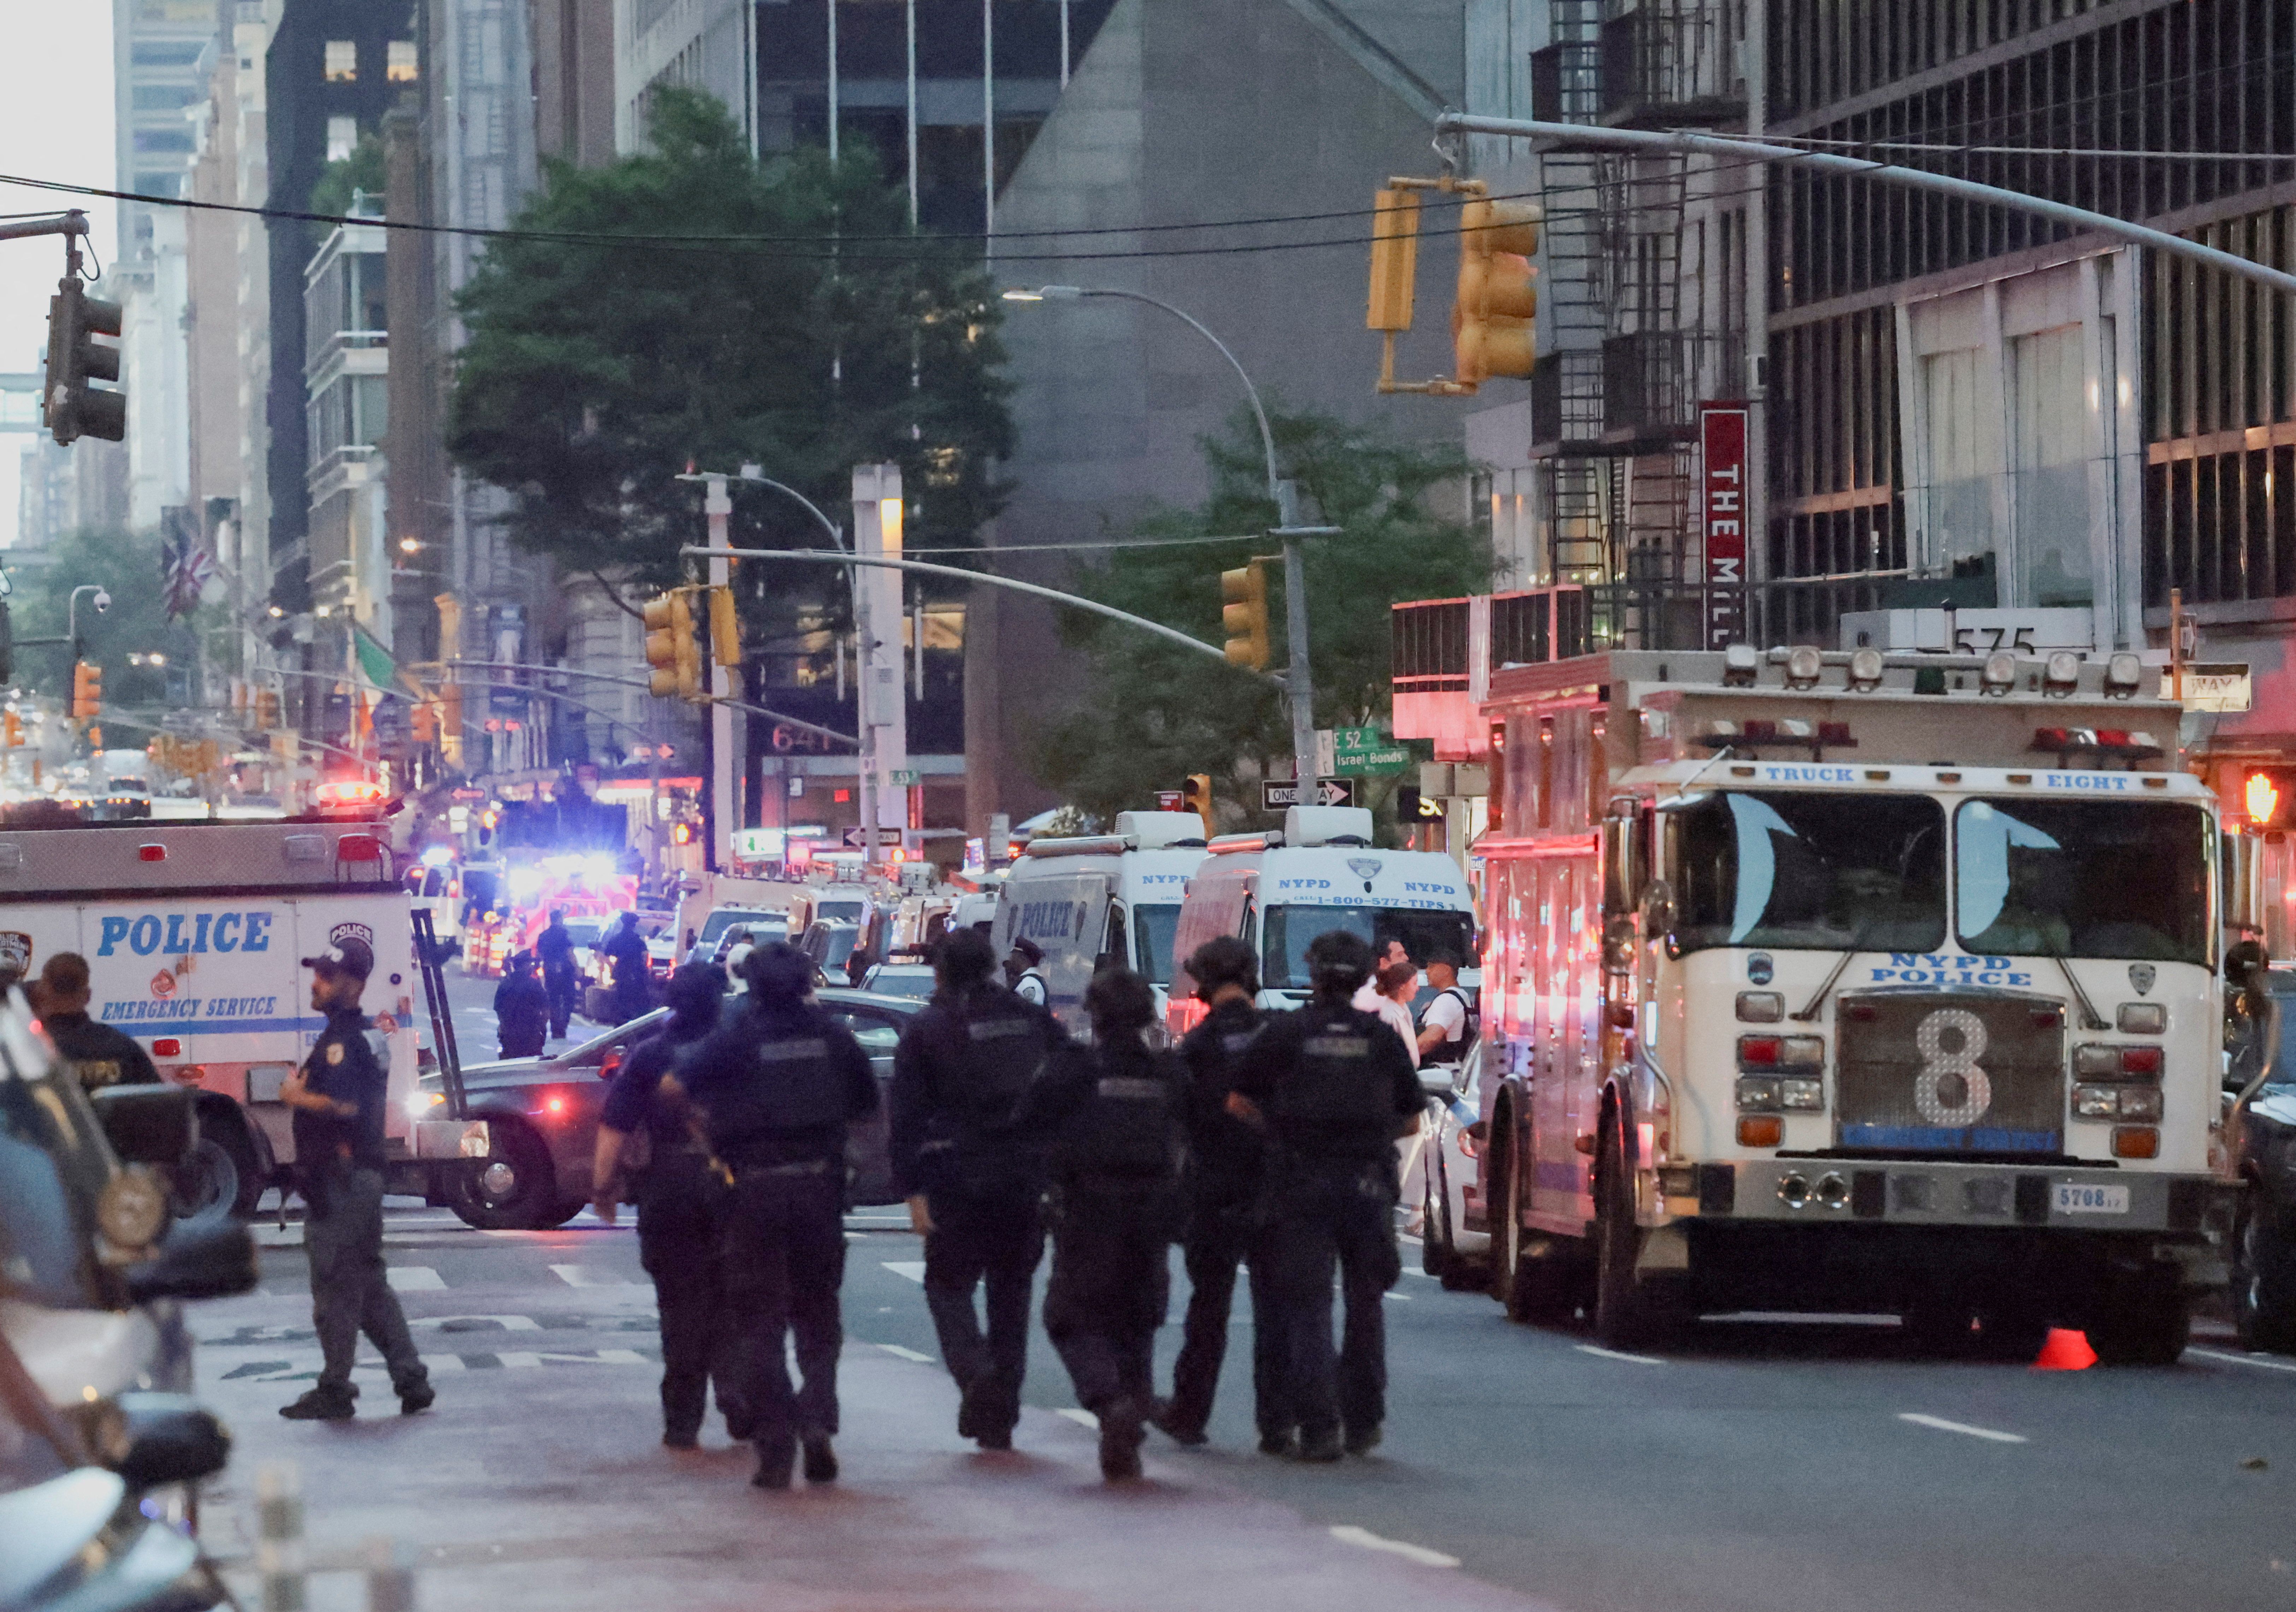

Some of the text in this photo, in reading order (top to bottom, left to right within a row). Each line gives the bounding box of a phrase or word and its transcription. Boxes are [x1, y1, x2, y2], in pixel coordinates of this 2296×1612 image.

[1712, 464, 1739, 536] THE
[1955, 627, 2035, 655] 575
[1346, 731, 1361, 749] 52
[1337, 751, 1402, 766] Israel Bonds
[1766, 767, 2128, 790] TRUCK EIGHT
[1273, 788, 1335, 801] ONE AY
[1279, 880, 1331, 889] NYPD
[1404, 882, 1455, 894] NYPD
[1317, 896, 1445, 909] 1-800-577-TIPS
[1020, 901, 1073, 937] POLICE
[97, 912, 272, 956] POLICE
[331, 924, 371, 942] POLICE
[1890, 953, 2011, 970] NYPD
[1871, 969, 2031, 986] POLICE
[101, 996, 277, 1020] EMERGENCY SERVICE
[1914, 1008, 1991, 1128] 8
[2060, 1188, 2104, 1207] 5708
